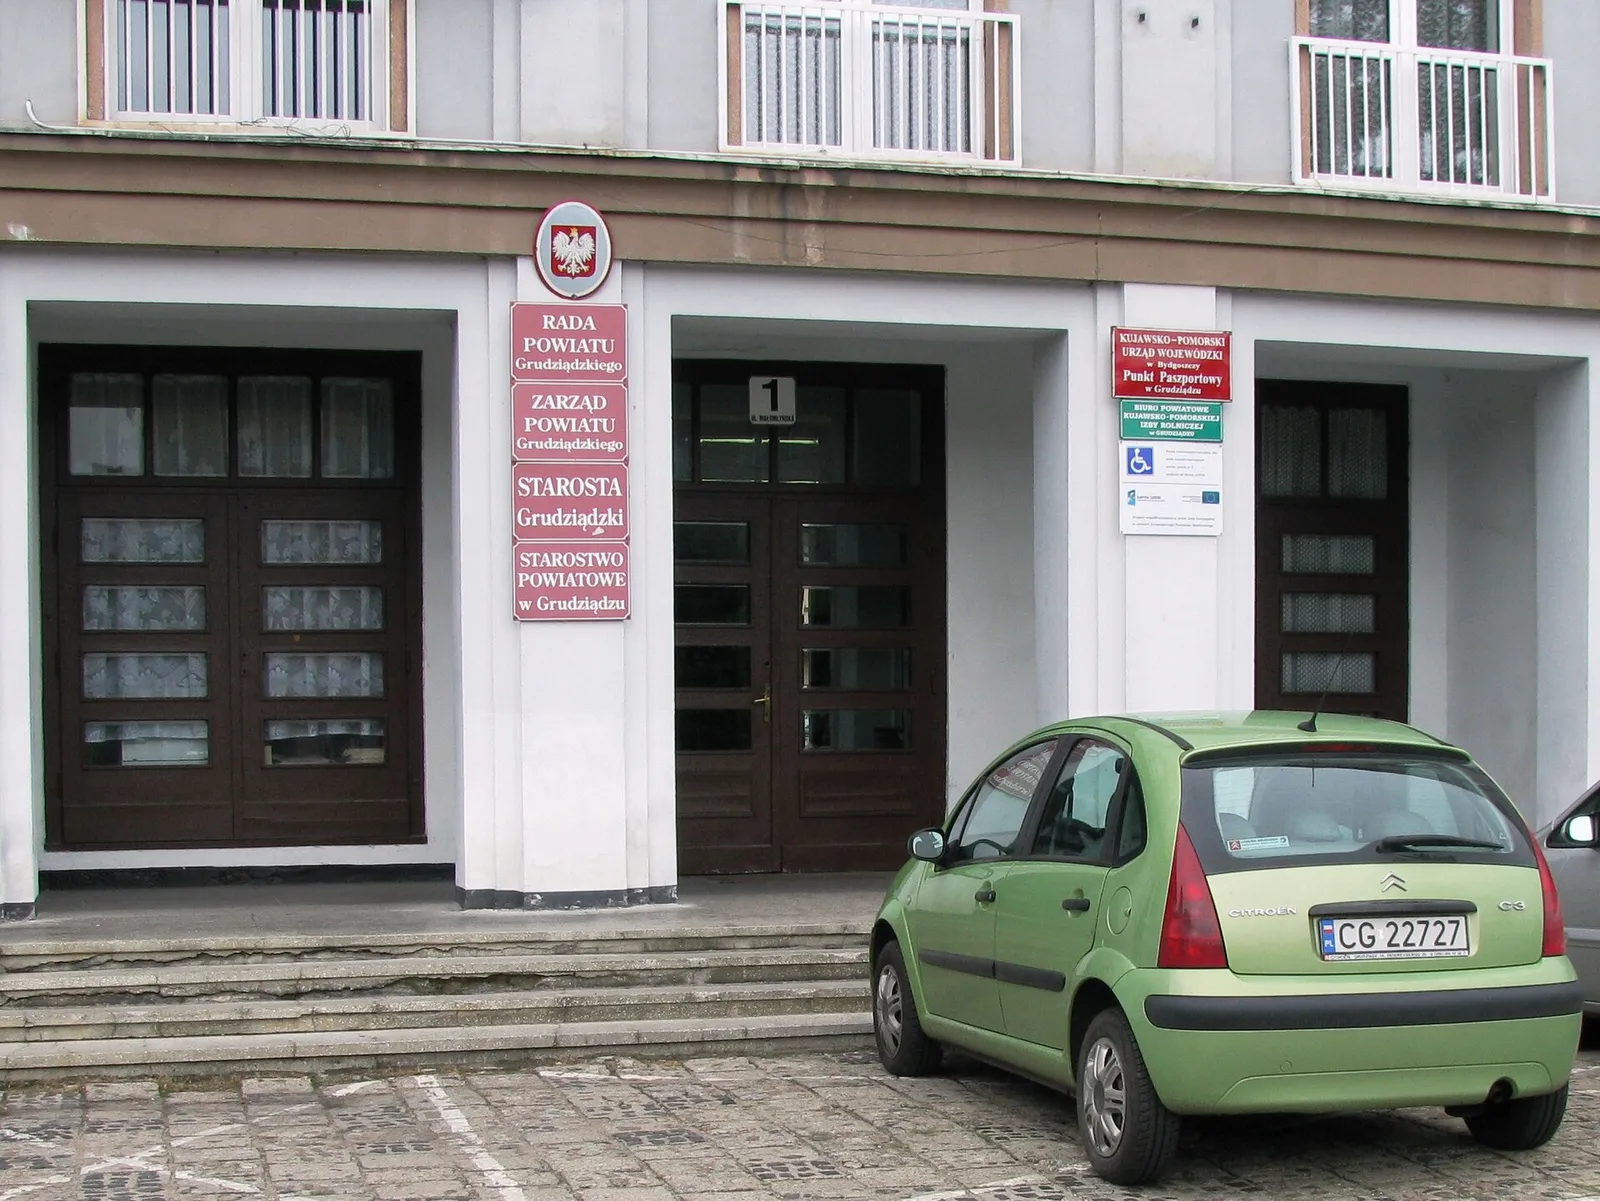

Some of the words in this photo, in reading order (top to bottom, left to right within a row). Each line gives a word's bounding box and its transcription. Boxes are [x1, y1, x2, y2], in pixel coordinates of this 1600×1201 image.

[542, 314, 597, 331] RADA
[523, 337, 616, 354] POWIATU
[1119, 333, 1226, 347] KUJAWSKO-POMORSKI
[1122, 347, 1156, 360] URZĄD
[1157, 348, 1223, 360] WOJEWÓDZKI
[515, 357, 623, 374] Grudziądzkiego
[1157, 361, 1201, 371] Bydgoszczy
[1123, 369, 1154, 382] Punkt
[1160, 371, 1223, 387] Paszportowy
[762, 378, 779, 411] 1
[1154, 384, 1202, 396] Grudziądzu
[531, 394, 607, 414] ZARZĄD
[1134, 403, 1159, 412] BIURO
[1160, 404, 1209, 413] POWIATOWE
[524, 417, 616, 433] POWIATU
[1140, 421, 1159, 429] IZBY
[1160, 421, 1204, 430] ROLNICZEJ
[516, 436, 624, 453] Grudziądzkiego
[517, 476, 623, 497] STAROSTA
[517, 507, 624, 532] Grudziądzki
[519, 552, 624, 568] STAROSTWO
[518, 571, 627, 588] POWIATOWE
[518, 599, 533, 612] w
[536, 595, 626, 616] Grudziądzu
[1228, 906, 1297, 918] CITROËN
[1497, 900, 1526, 912] C3
[1338, 922, 1377, 949] CG
[1385, 920, 1461, 948] 22727
[1324, 940, 1335, 948] PL
